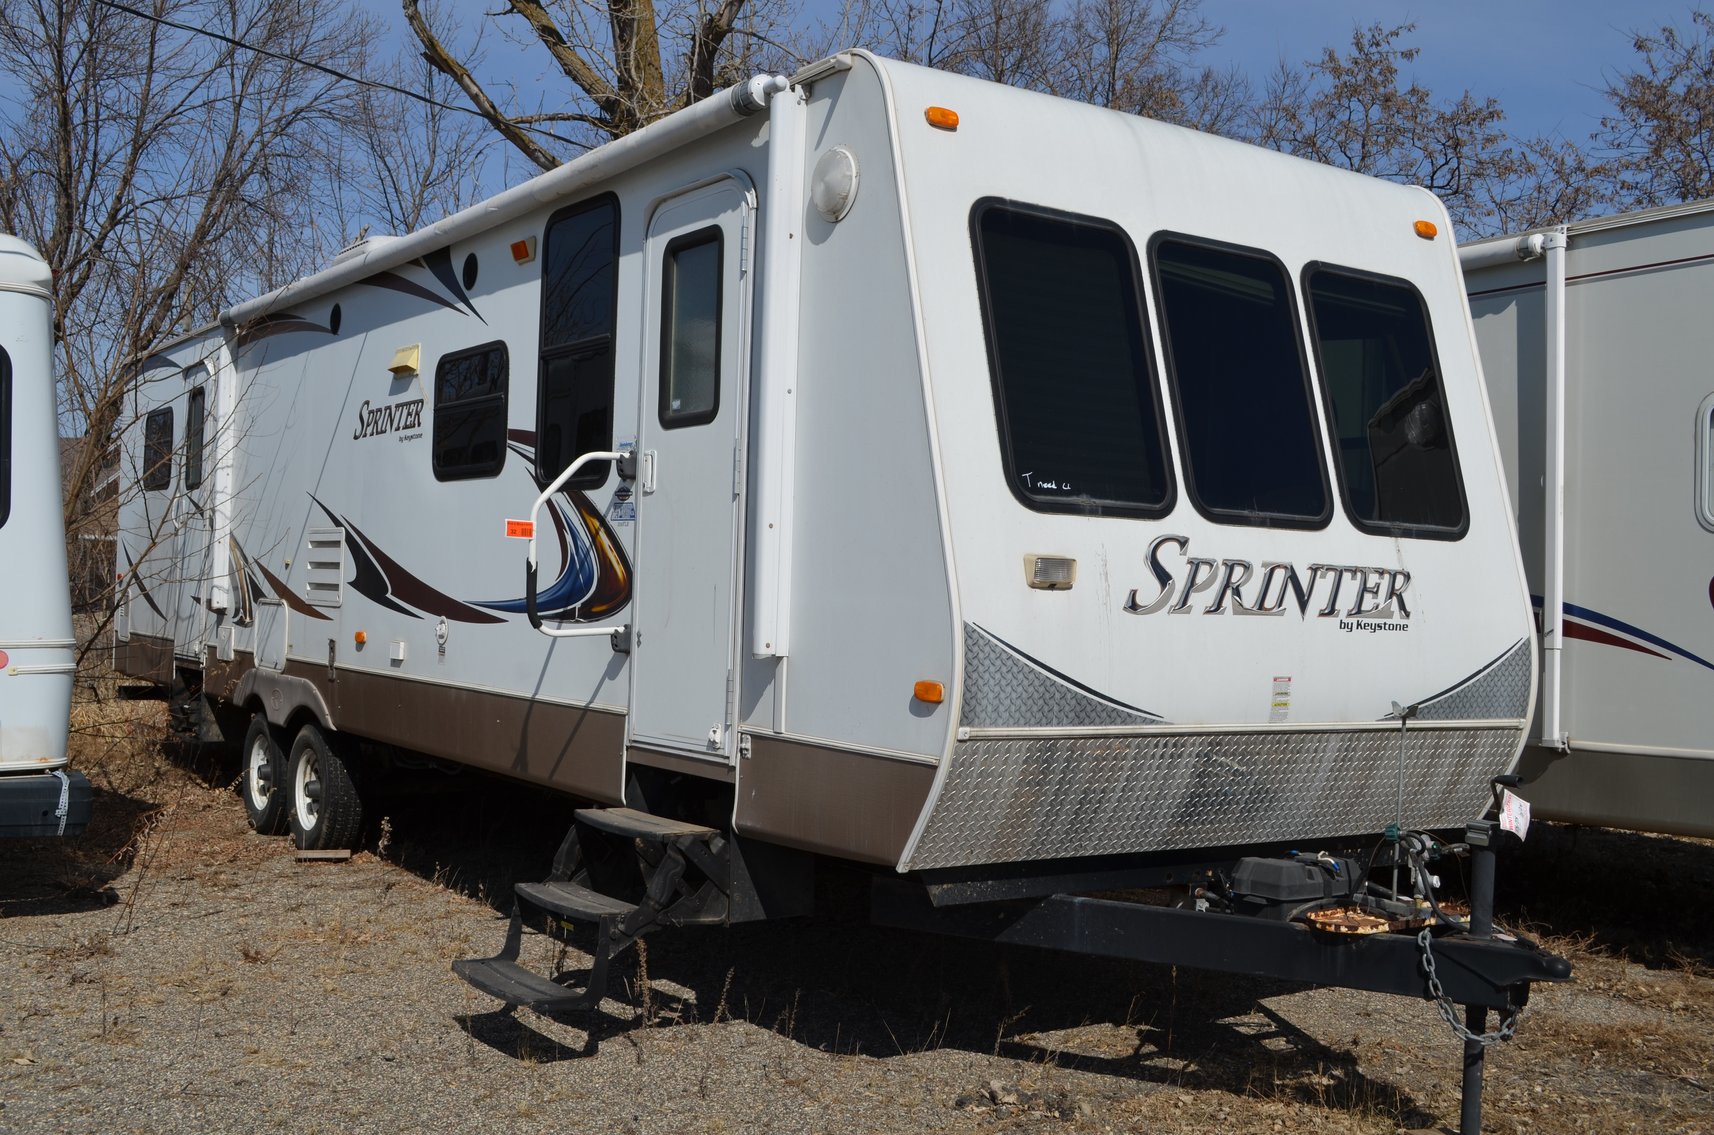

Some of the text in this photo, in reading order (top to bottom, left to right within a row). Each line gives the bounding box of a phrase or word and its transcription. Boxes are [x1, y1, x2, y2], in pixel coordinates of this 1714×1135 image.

[353, 399, 424, 440] SPRINTER
[1037, 480, 1057, 489] need
[1122, 533, 1411, 620] SPRINTER
[1339, 619, 1409, 633] by Keystone
